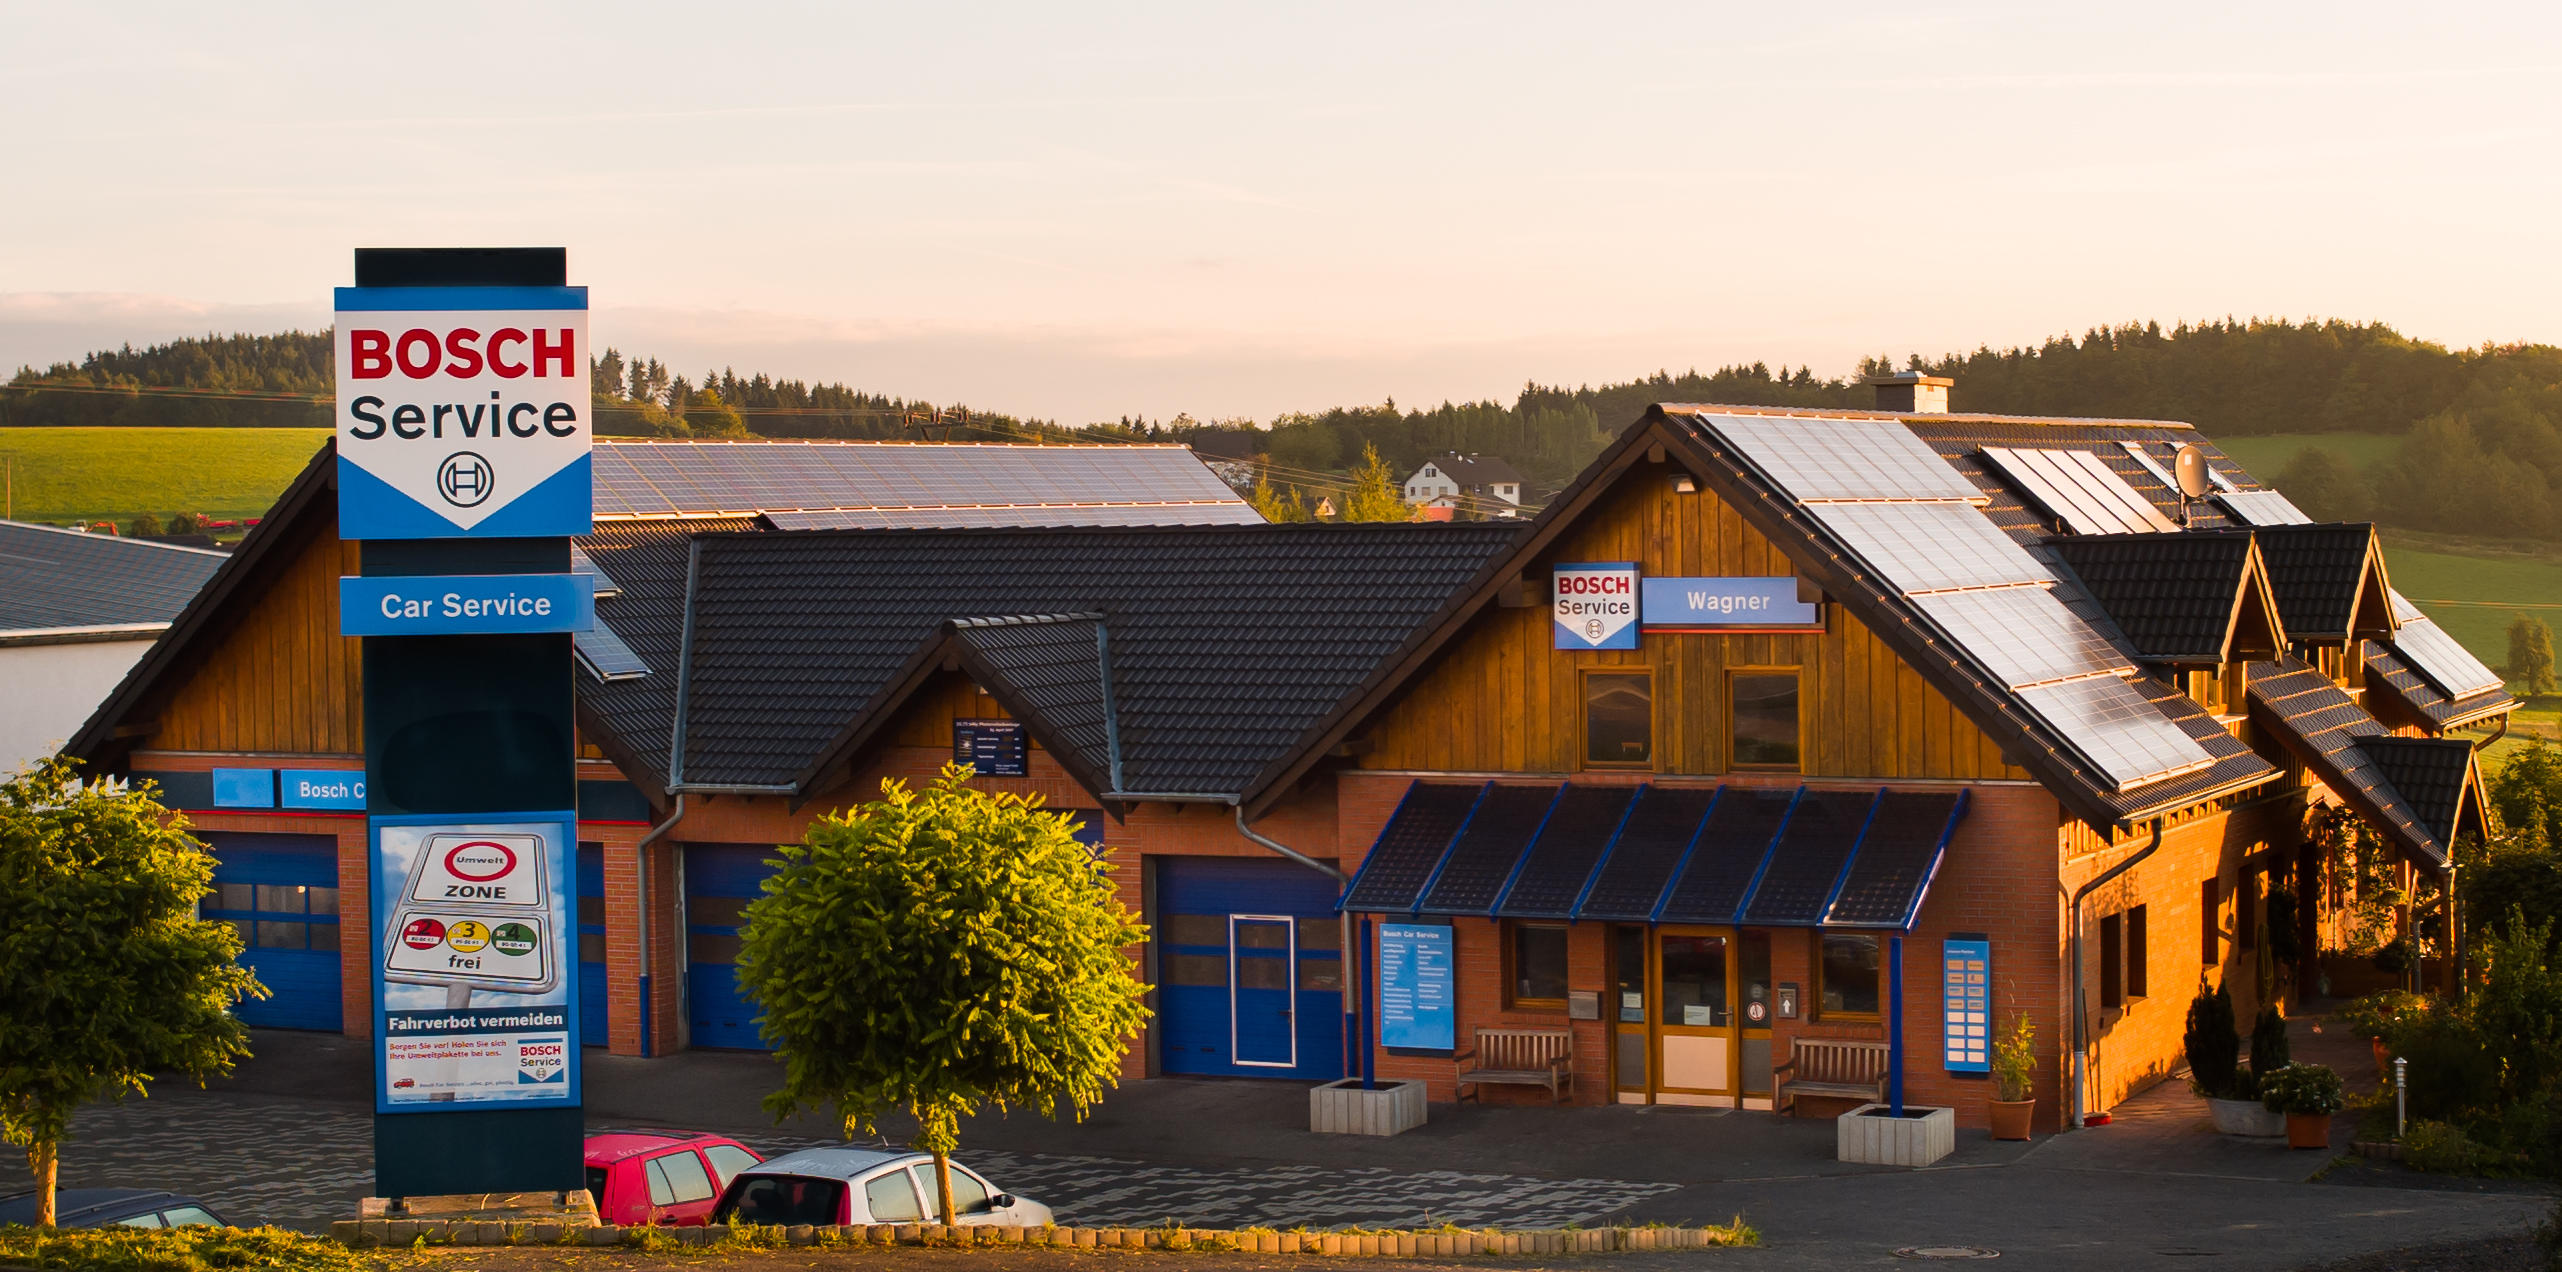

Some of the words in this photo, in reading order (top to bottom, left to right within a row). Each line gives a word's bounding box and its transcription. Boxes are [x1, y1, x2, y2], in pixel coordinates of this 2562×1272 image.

[350, 327, 575, 380] BOSCH
[349, 391, 577, 440] Service
[1558, 576, 1631, 595] BOSCH
[380, 594, 433, 620] Car
[442, 592, 552, 618] Service
[1558, 597, 1631, 615] Service
[1687, 591, 1771, 614] Wagner
[299, 781, 348, 798] Bosch
[456, 855, 505, 865] Umwelt
[445, 885, 507, 899] ZONE
[419, 920, 431, 936] 2
[462, 922, 476, 938] 3
[507, 924, 521, 940] 4
[448, 954, 481, 969] frei
[388, 1014, 476, 1031] Fahrverbot
[479, 1012, 563, 1028] vermeiden
[418, 1041, 432, 1050] Sie
[451, 1040, 475, 1048] Holen
[490, 1039, 507, 1047] sich
[520, 1045, 562, 1056] BOSCH
[389, 1052, 406, 1060] Ihre
[520, 1057, 562, 1067] Service
